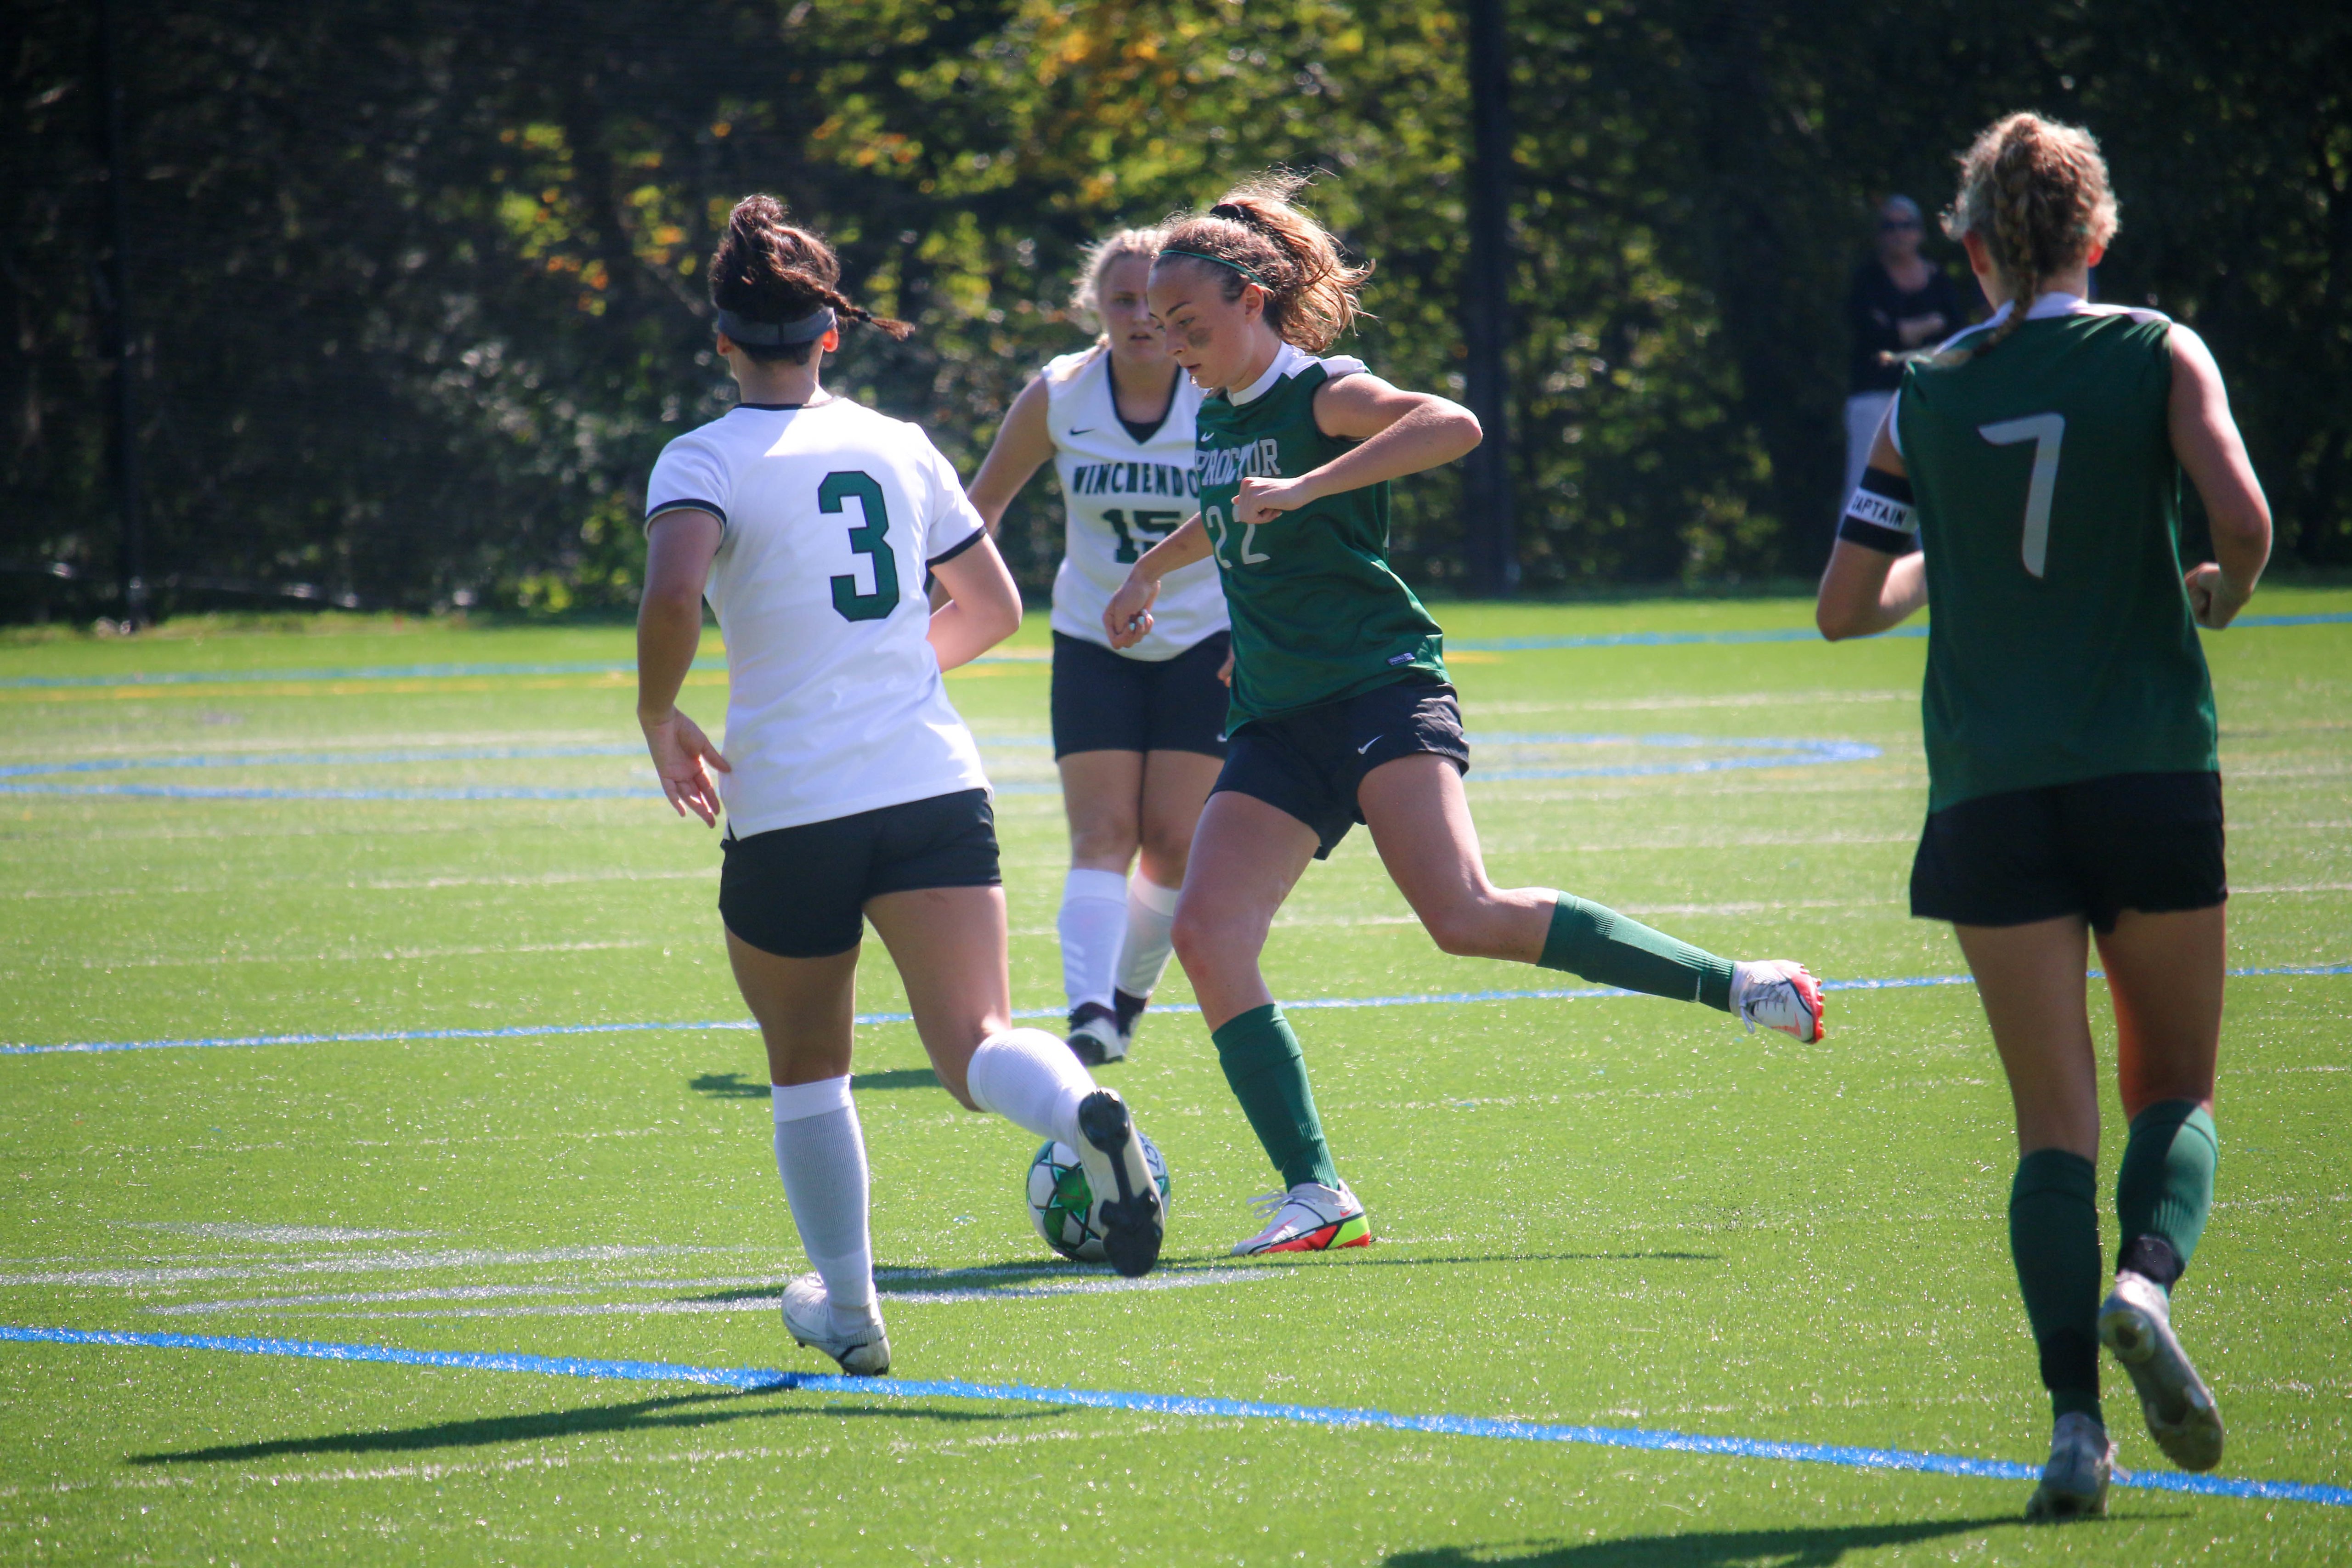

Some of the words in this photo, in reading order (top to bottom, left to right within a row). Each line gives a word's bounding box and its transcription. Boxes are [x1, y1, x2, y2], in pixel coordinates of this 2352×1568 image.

[1072, 462, 1201, 498] WINCHENDO
[1195, 438, 1282, 486] PROCTOR
[1852, 495, 1907, 526] CAPTAIN
[1977, 412, 2066, 578] 7
[817, 470, 899, 622] 3
[1101, 508, 1181, 564] 15
[1206, 505, 1271, 569] 22
